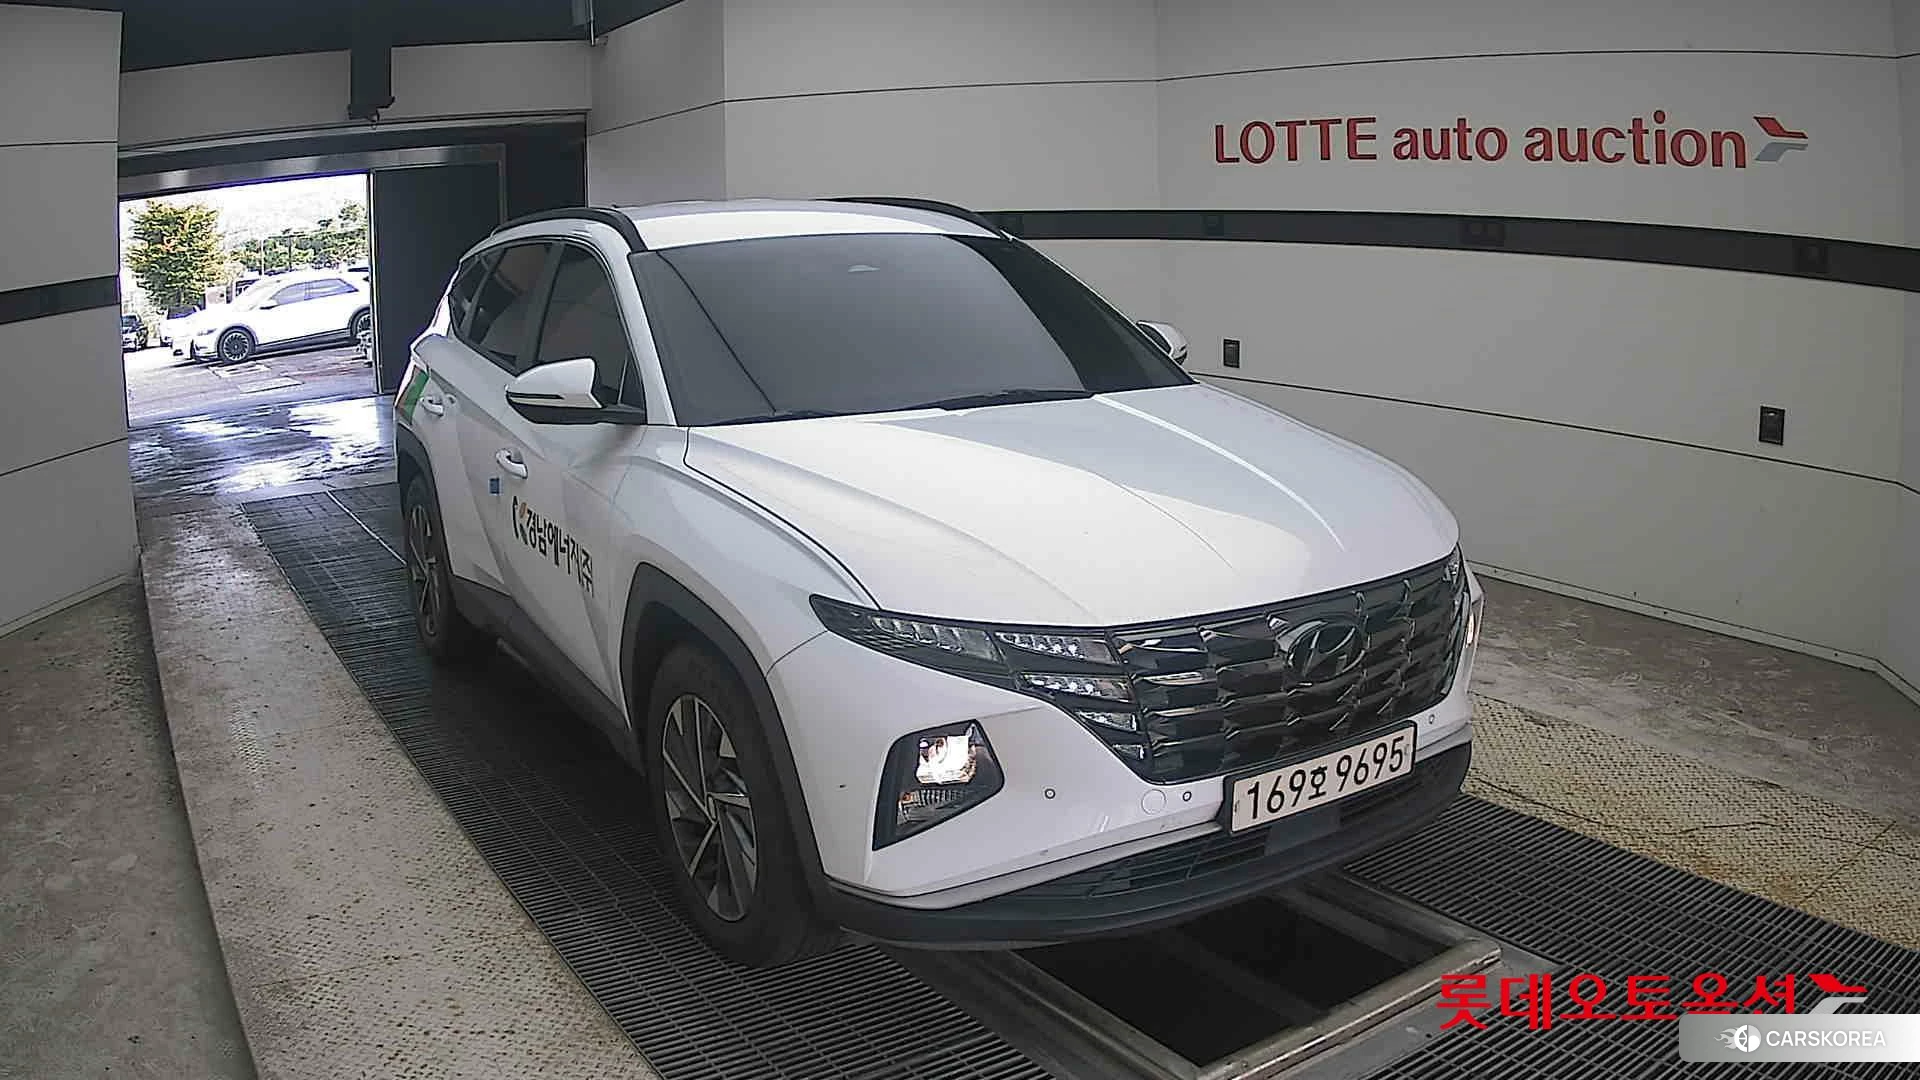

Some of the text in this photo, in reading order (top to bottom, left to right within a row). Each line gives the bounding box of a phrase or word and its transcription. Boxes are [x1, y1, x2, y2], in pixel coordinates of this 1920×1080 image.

[1215, 110, 1747, 169] LOTTE auto auction
[1247, 735, 1405, 820] 169호 9695
